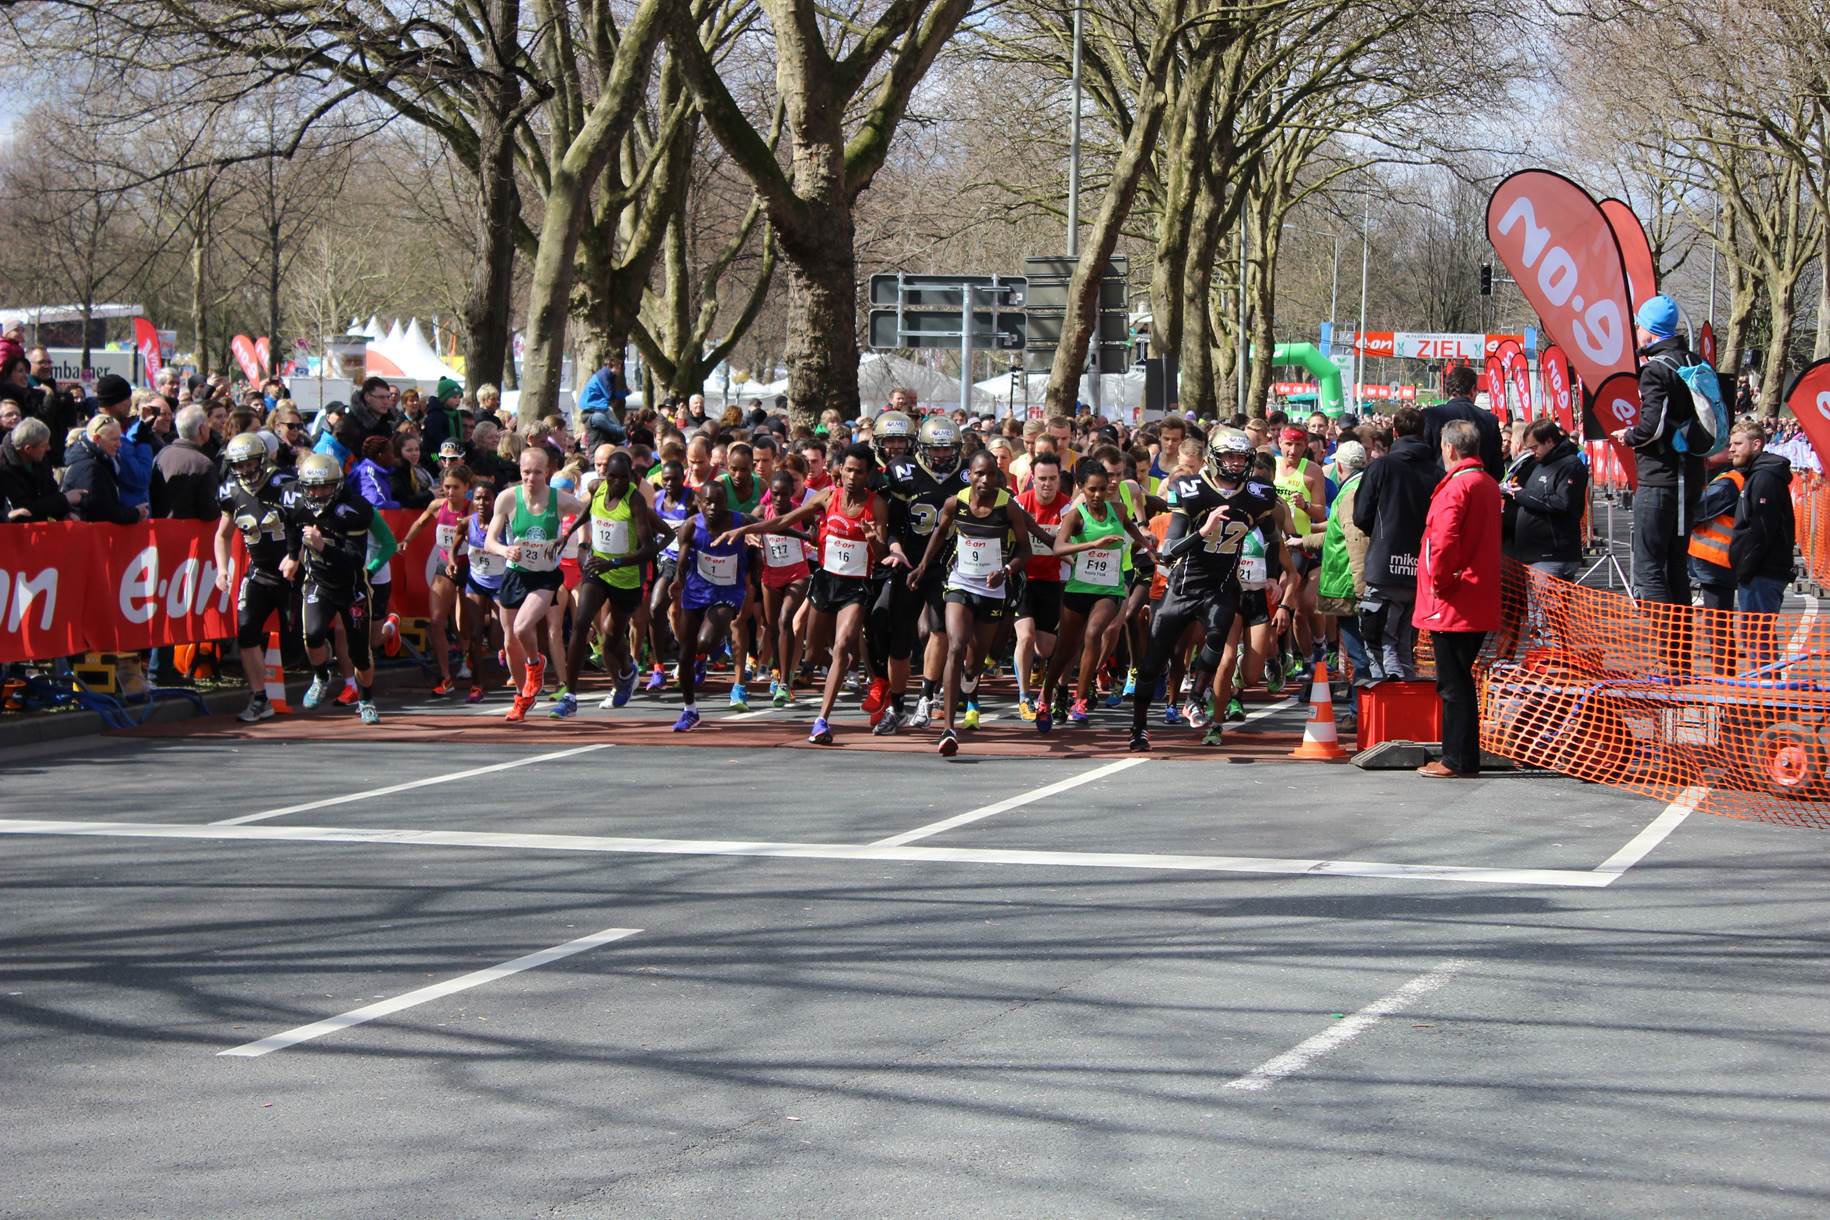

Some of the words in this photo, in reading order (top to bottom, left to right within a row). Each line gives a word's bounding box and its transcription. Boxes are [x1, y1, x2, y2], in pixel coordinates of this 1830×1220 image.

[1416, 340, 1469, 358] ZIEL
[600, 530, 611, 542] 12
[1203, 520, 1249, 554] 42
[526, 549, 538, 560] 23
[838, 551, 850, 563] 16
[972, 551, 979, 562] 9
[711, 565, 716, 574] 1
[1087, 560, 1107, 572] F19
[1239, 569, 1250, 581] 21
